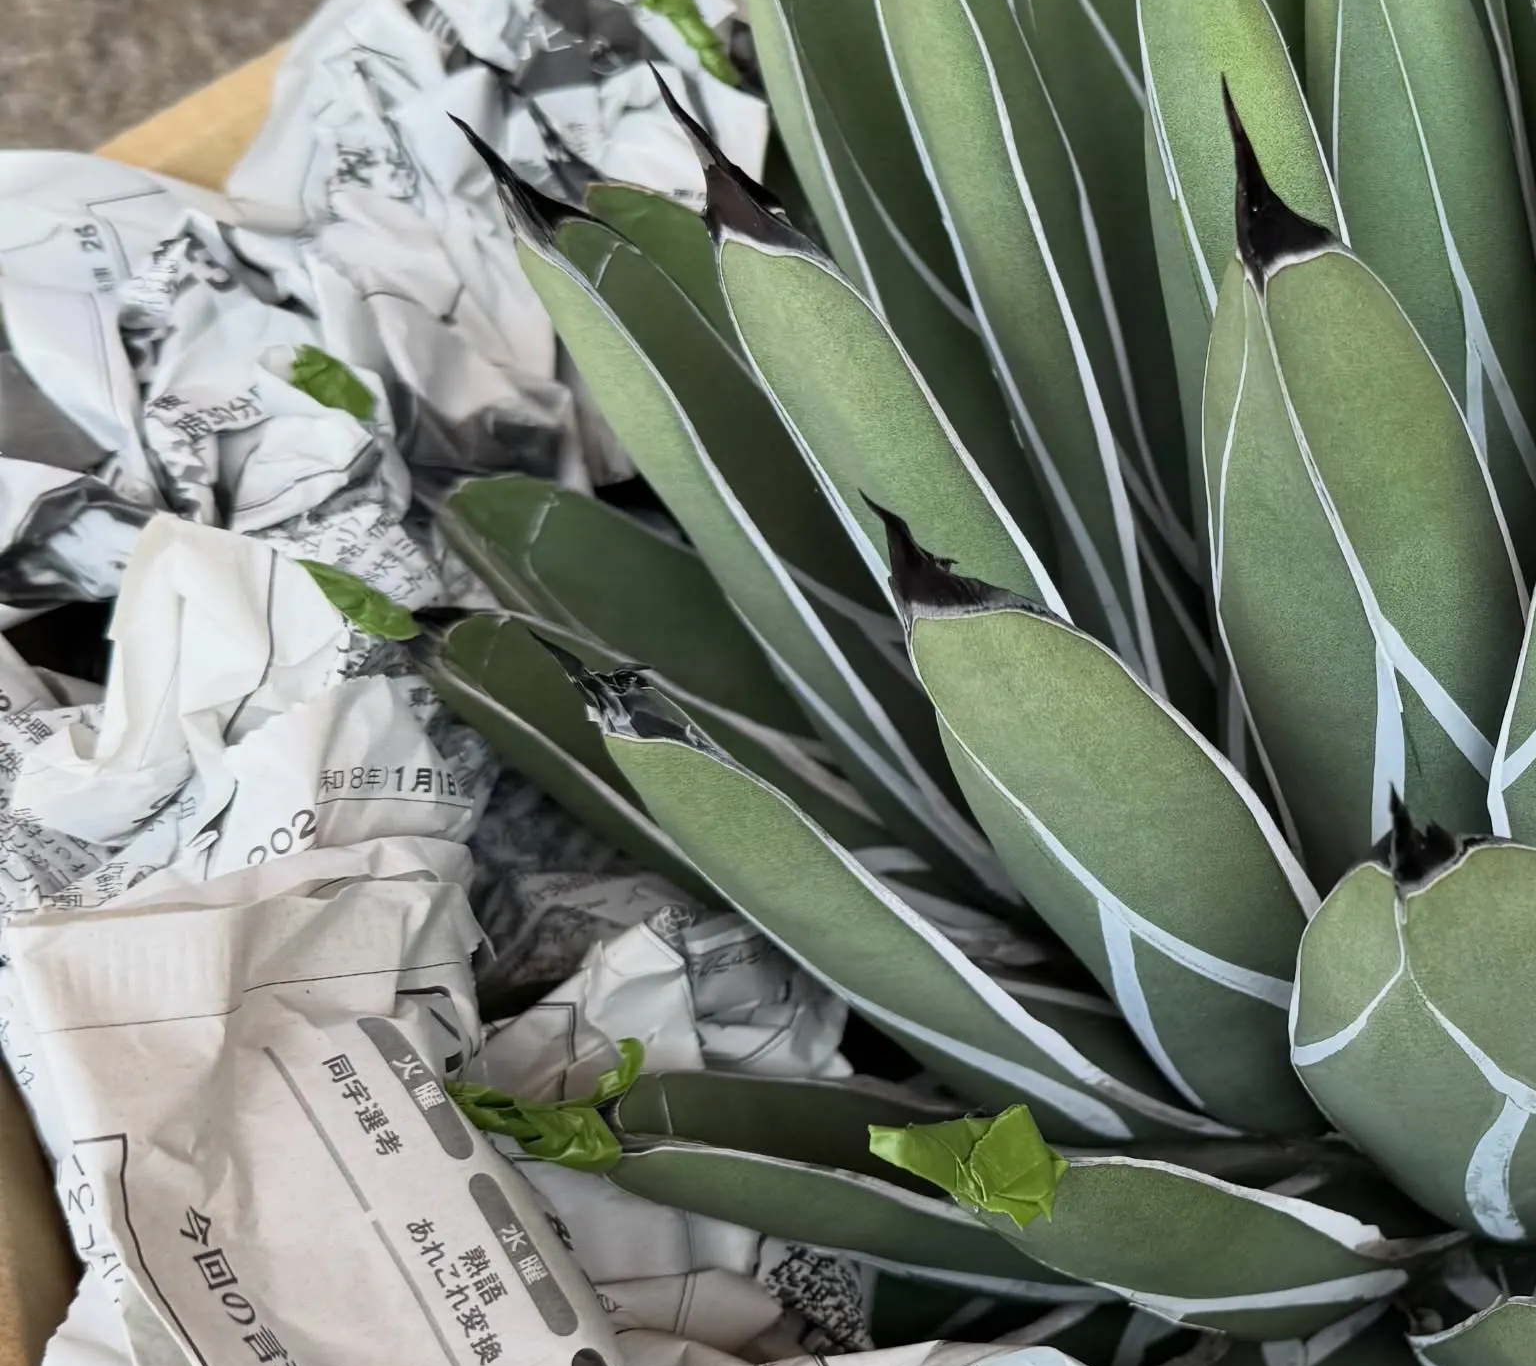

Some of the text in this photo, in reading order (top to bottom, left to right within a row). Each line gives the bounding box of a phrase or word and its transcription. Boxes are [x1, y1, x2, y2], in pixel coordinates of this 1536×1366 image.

[321, 1053, 404, 1156] 同字選考
[391, 1054, 446, 1111] 火曜
[458, 1245, 508, 1306] 熟語
[500, 1224, 549, 1285] 水曜
[406, 1218, 504, 1366] あれこれ変換
